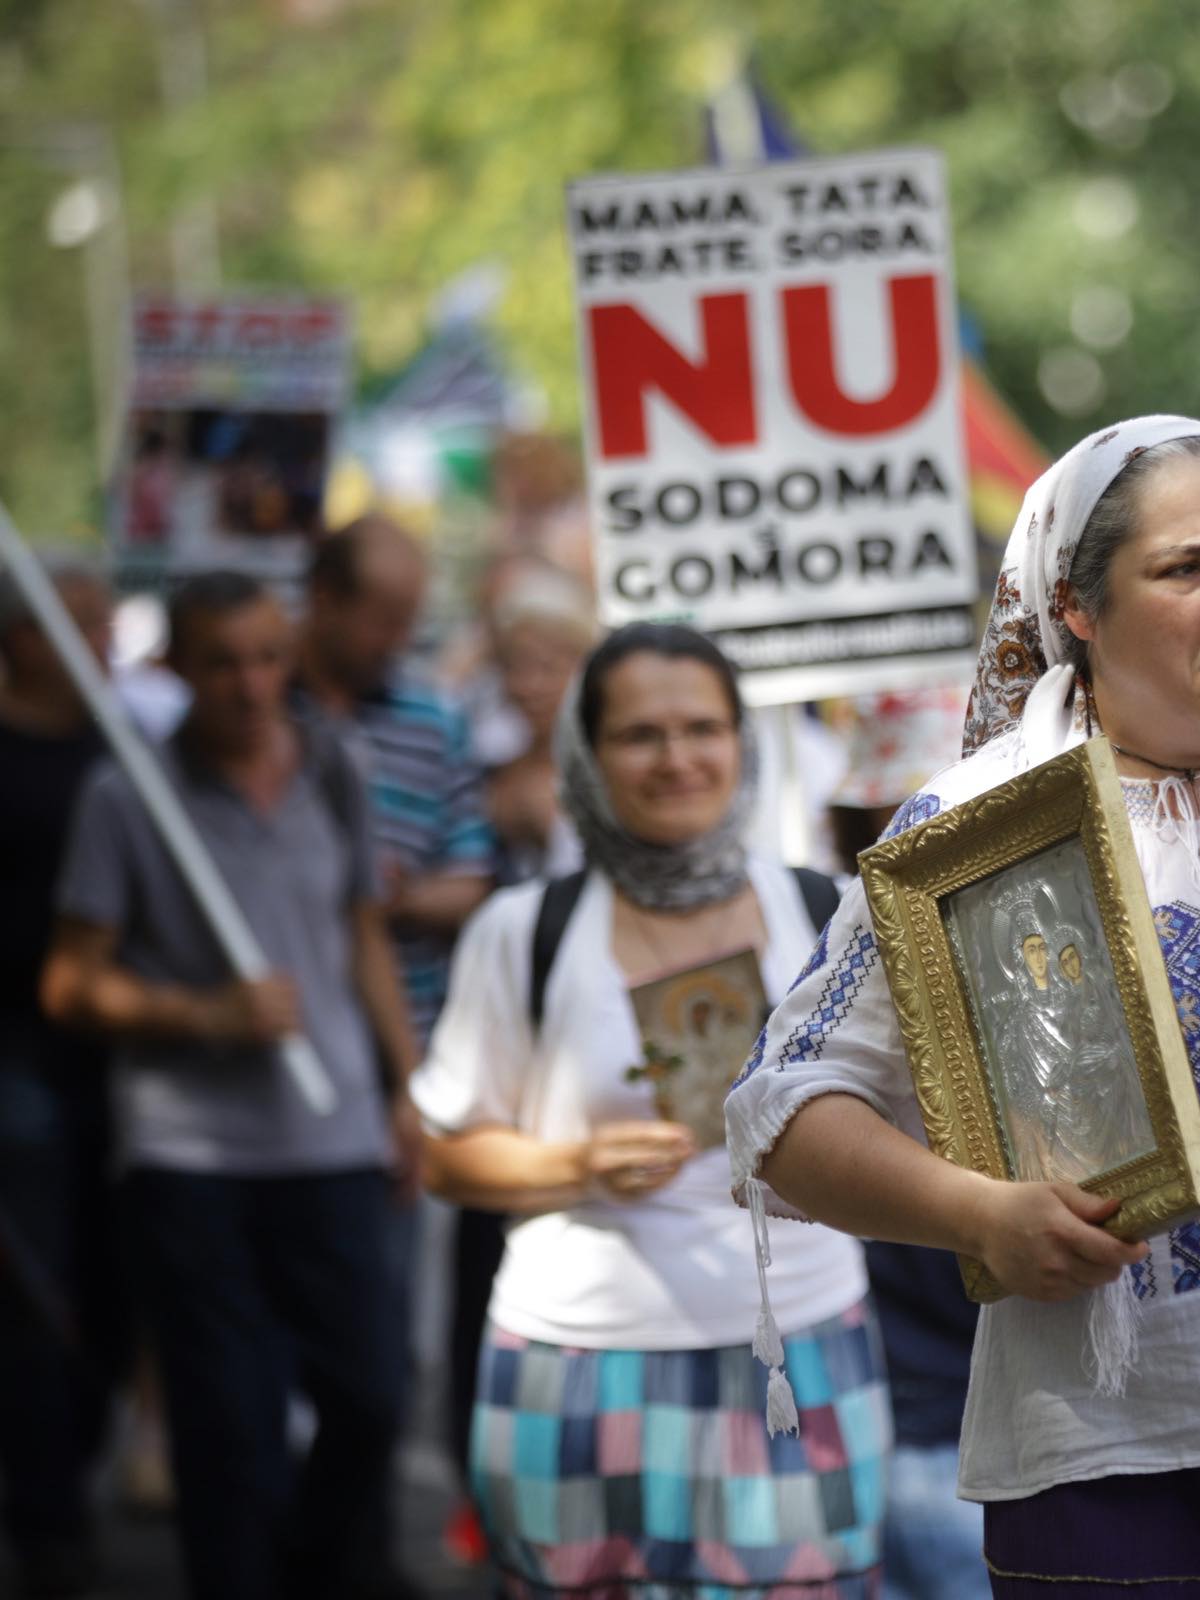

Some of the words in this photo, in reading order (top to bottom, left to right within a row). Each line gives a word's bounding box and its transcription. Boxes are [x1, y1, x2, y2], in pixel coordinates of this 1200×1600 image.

[588, 273, 941, 460] NU
[608, 459, 947, 534] SODOMA
[614, 532, 954, 601] GOMORA
